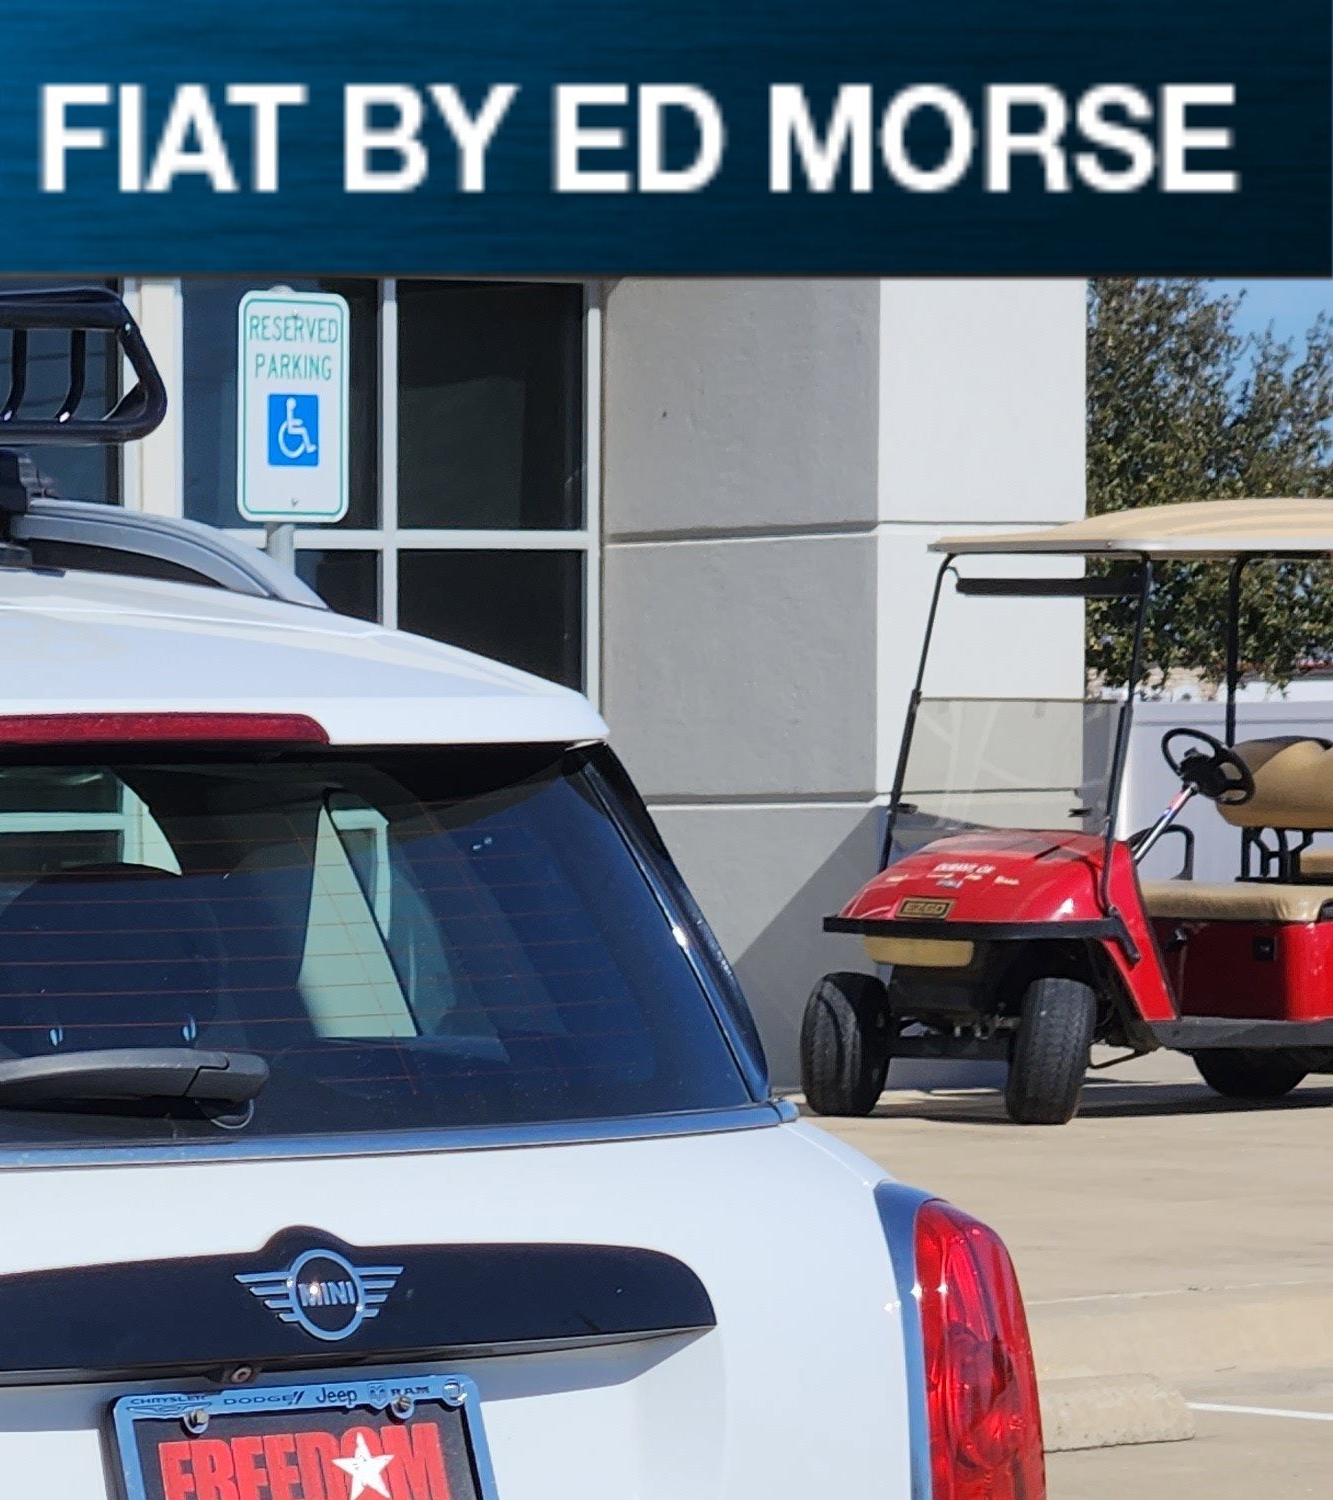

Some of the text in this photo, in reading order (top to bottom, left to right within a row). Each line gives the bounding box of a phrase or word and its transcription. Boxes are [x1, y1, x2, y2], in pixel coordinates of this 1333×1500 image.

[249, 315, 339, 343] RESERVED
[254, 352, 332, 381] PARKING
[297, 1280, 357, 1307] MINI
[315, 1387, 358, 1406] Jeep
[390, 1384, 430, 1397] RAM
